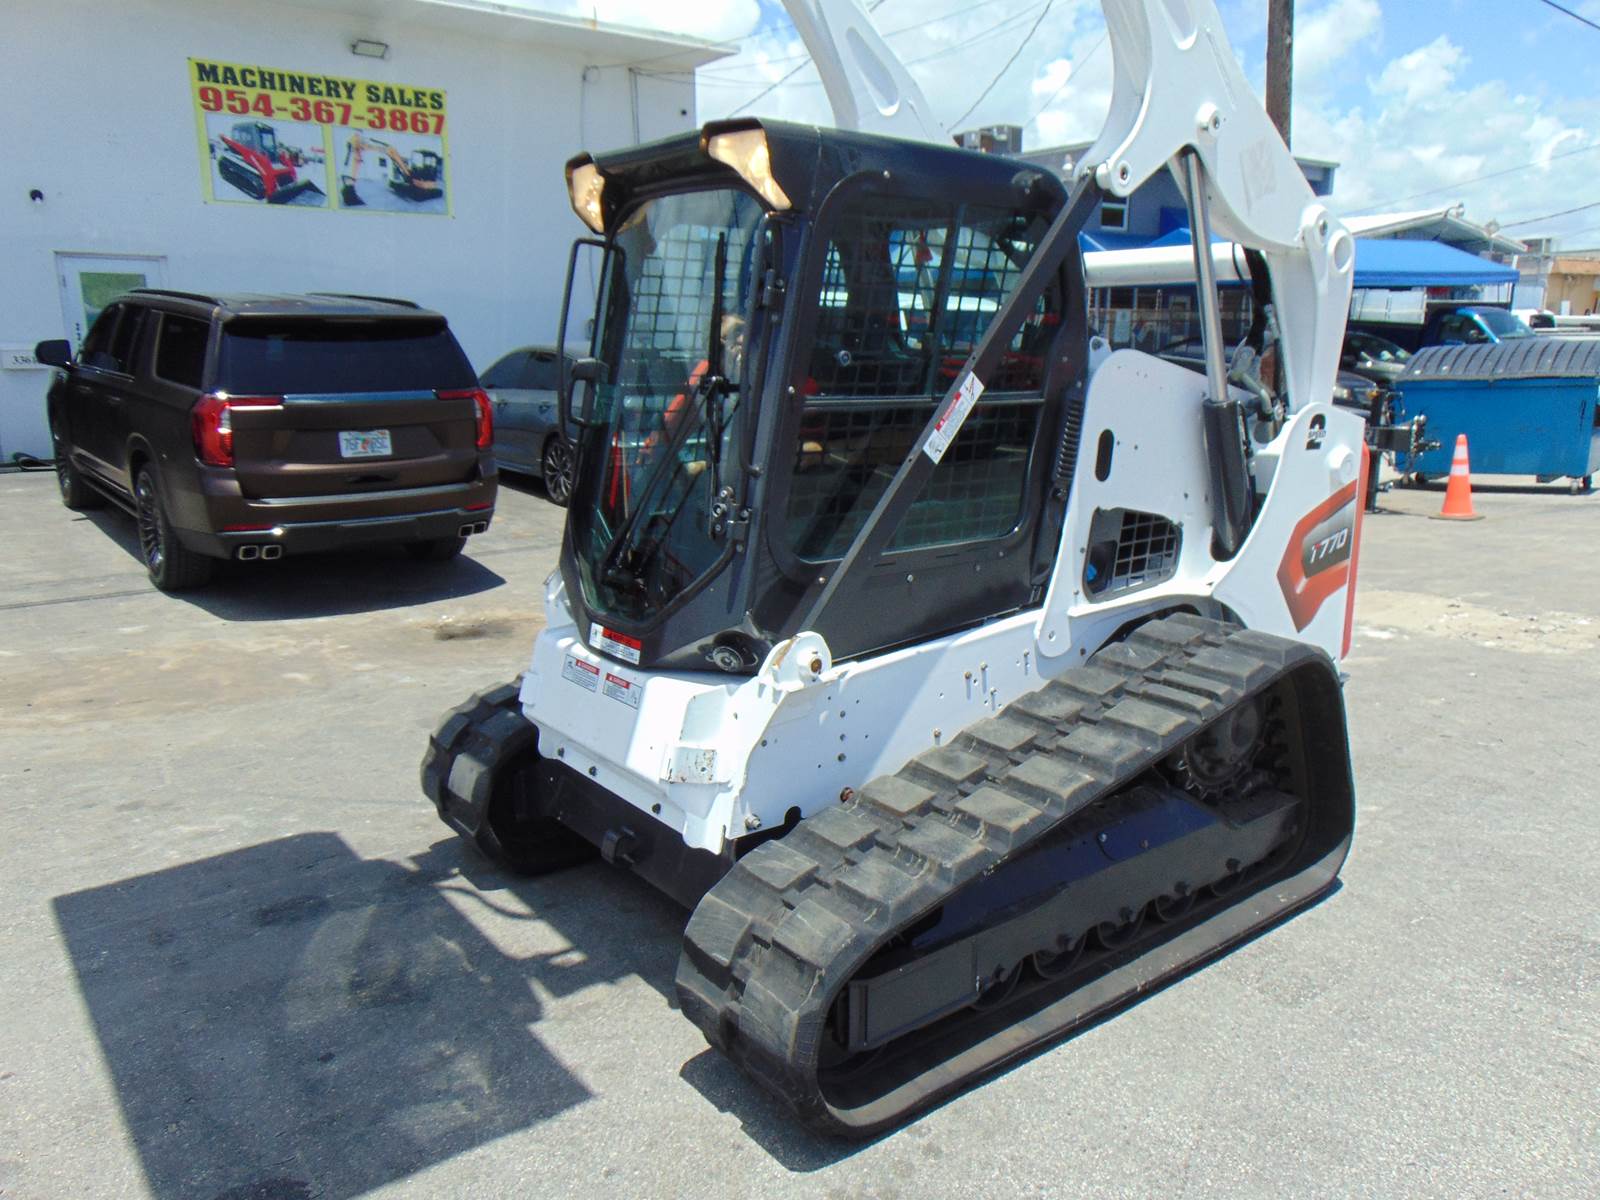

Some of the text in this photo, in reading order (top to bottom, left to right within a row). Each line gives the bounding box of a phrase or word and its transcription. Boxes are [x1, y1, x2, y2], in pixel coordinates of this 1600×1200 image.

[195, 62, 444, 110] MACHINERY SALES
[199, 86, 446, 135] 954-367-3867
[1310, 528, 1348, 564] T770
